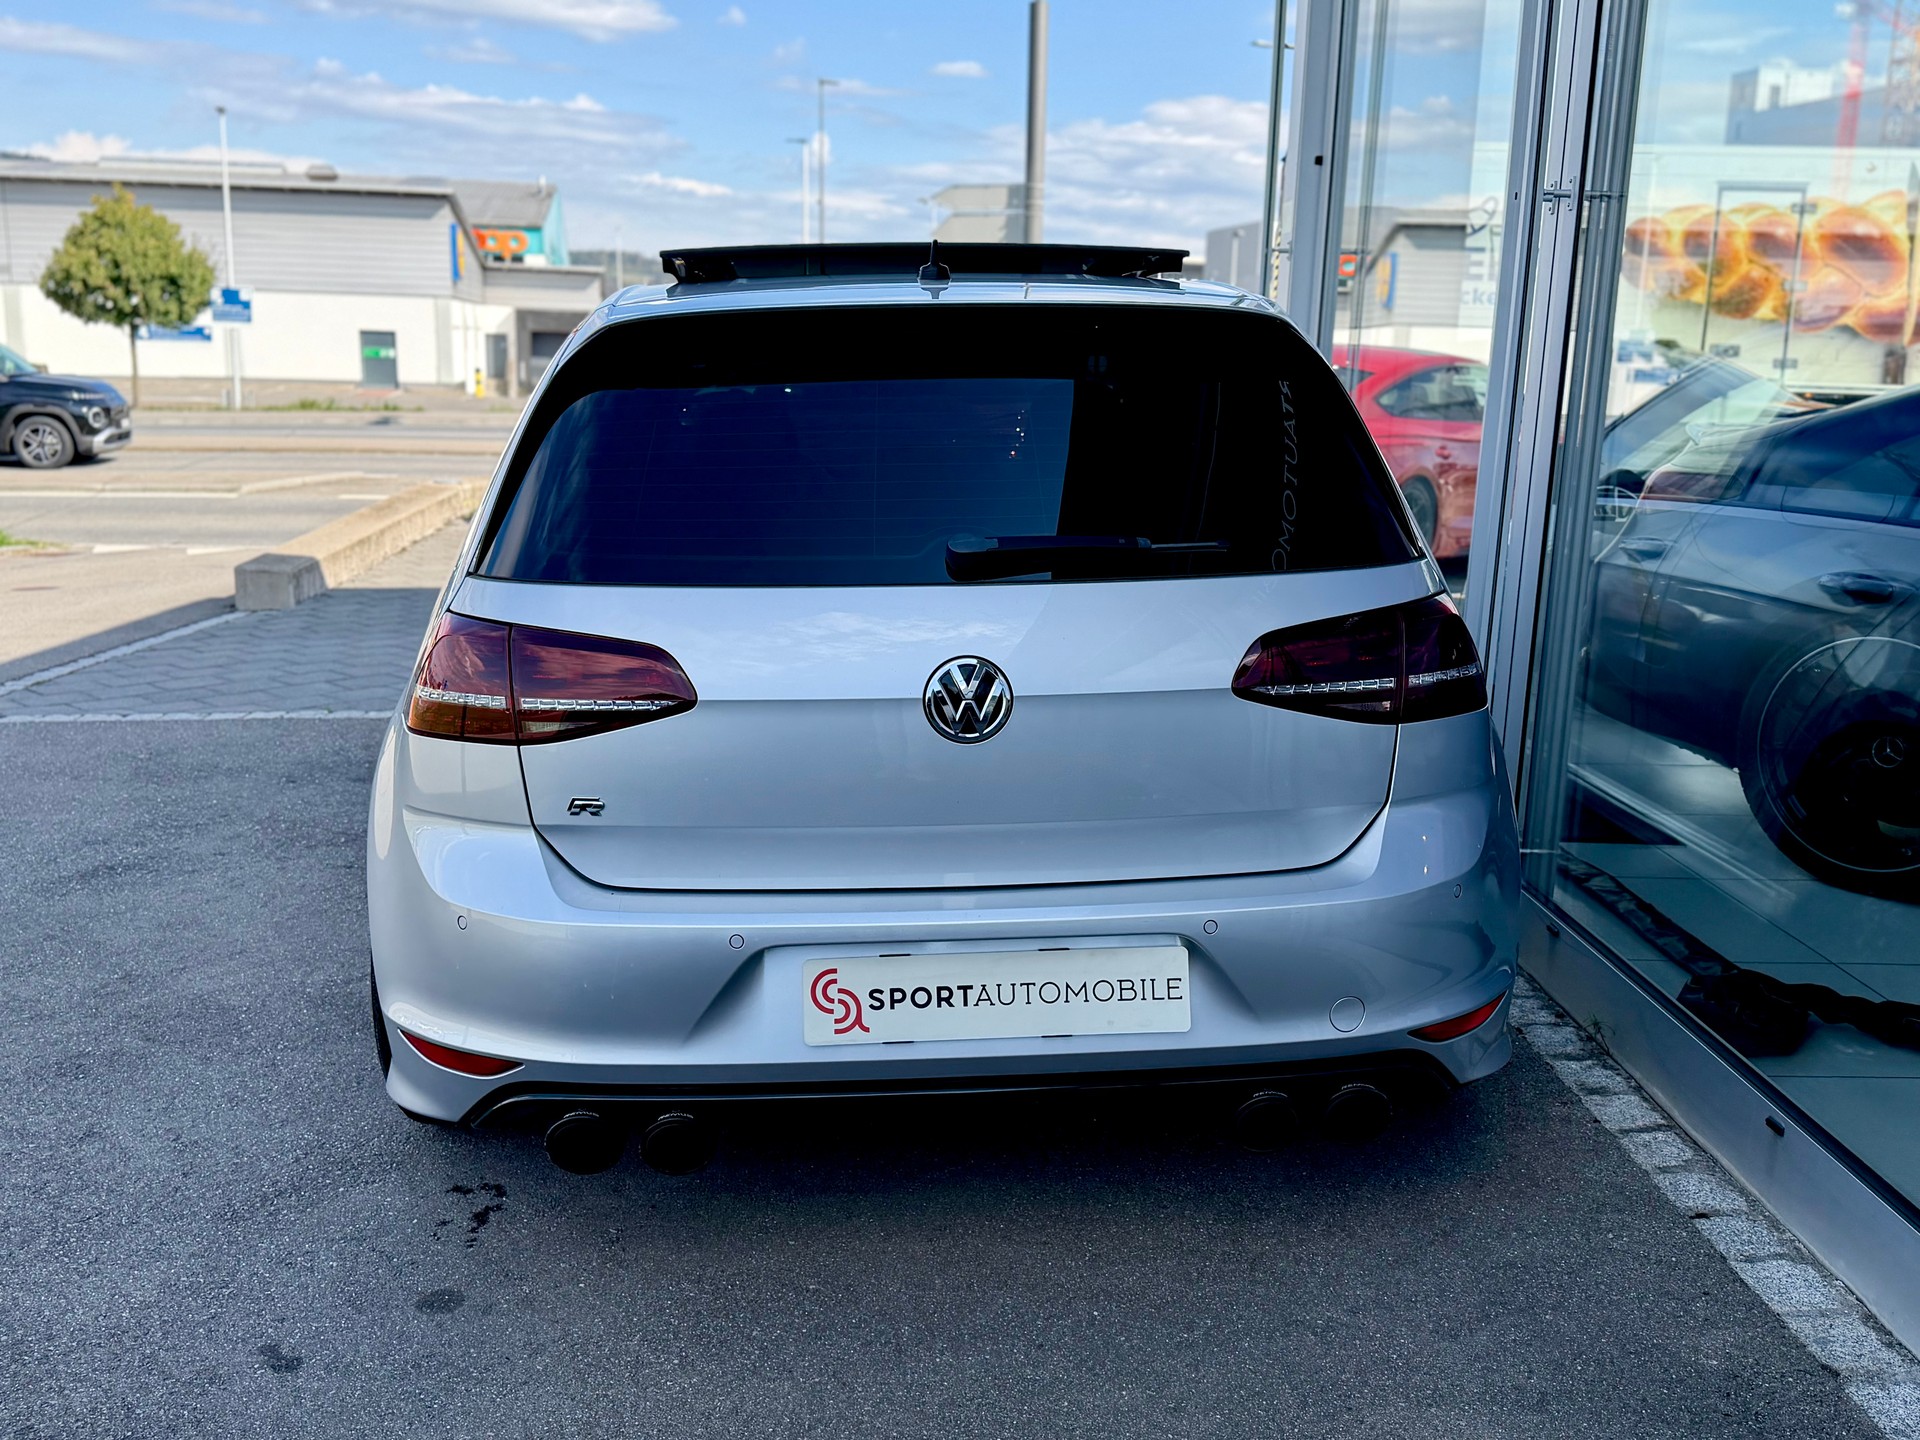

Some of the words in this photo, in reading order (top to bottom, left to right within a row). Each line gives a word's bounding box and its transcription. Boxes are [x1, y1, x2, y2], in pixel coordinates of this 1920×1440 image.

[471, 227, 528, 259] op
[567, 796, 605, 816] R
[868, 977, 1183, 1011] SPORTAUTOMOBILE
